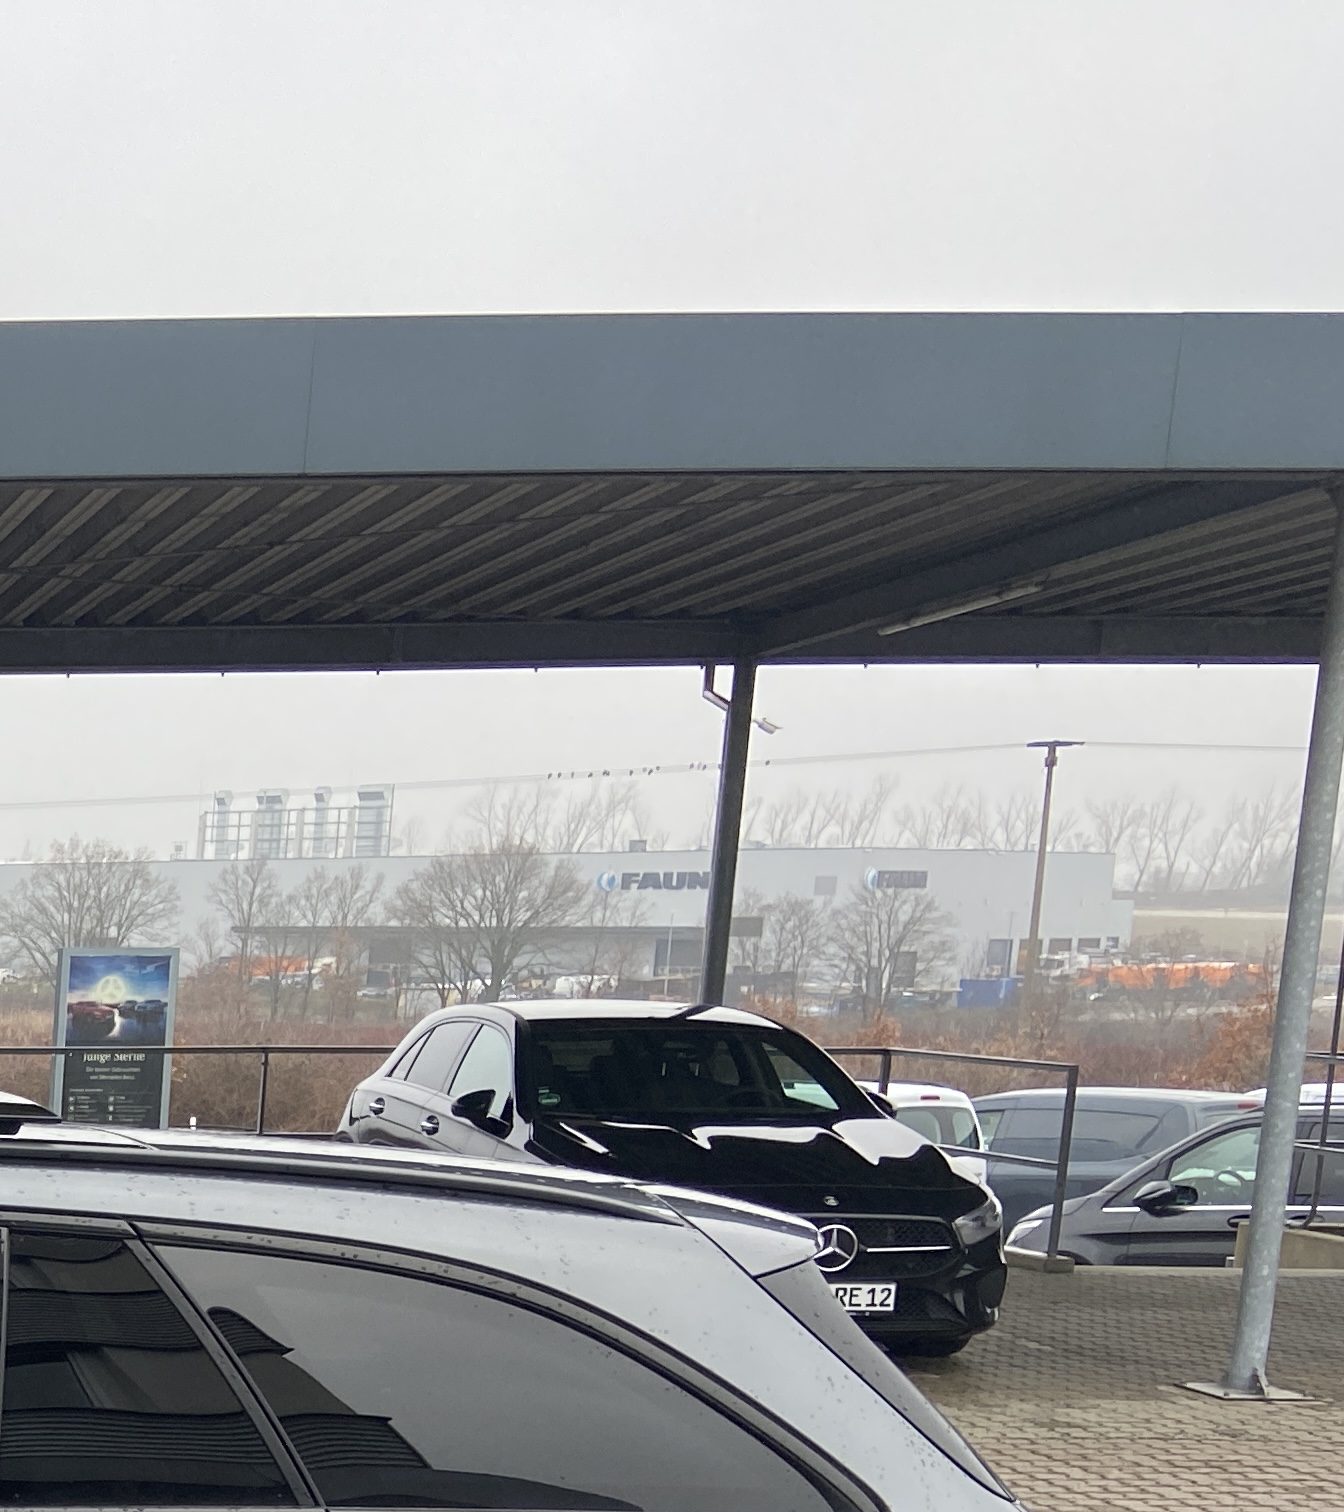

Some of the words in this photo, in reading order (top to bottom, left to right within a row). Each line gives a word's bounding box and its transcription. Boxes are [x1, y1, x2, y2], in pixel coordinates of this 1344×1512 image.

[620, 871, 711, 891] FAUN
[835, 1287, 862, 1308] RE
[865, 1287, 892, 1308] 12
